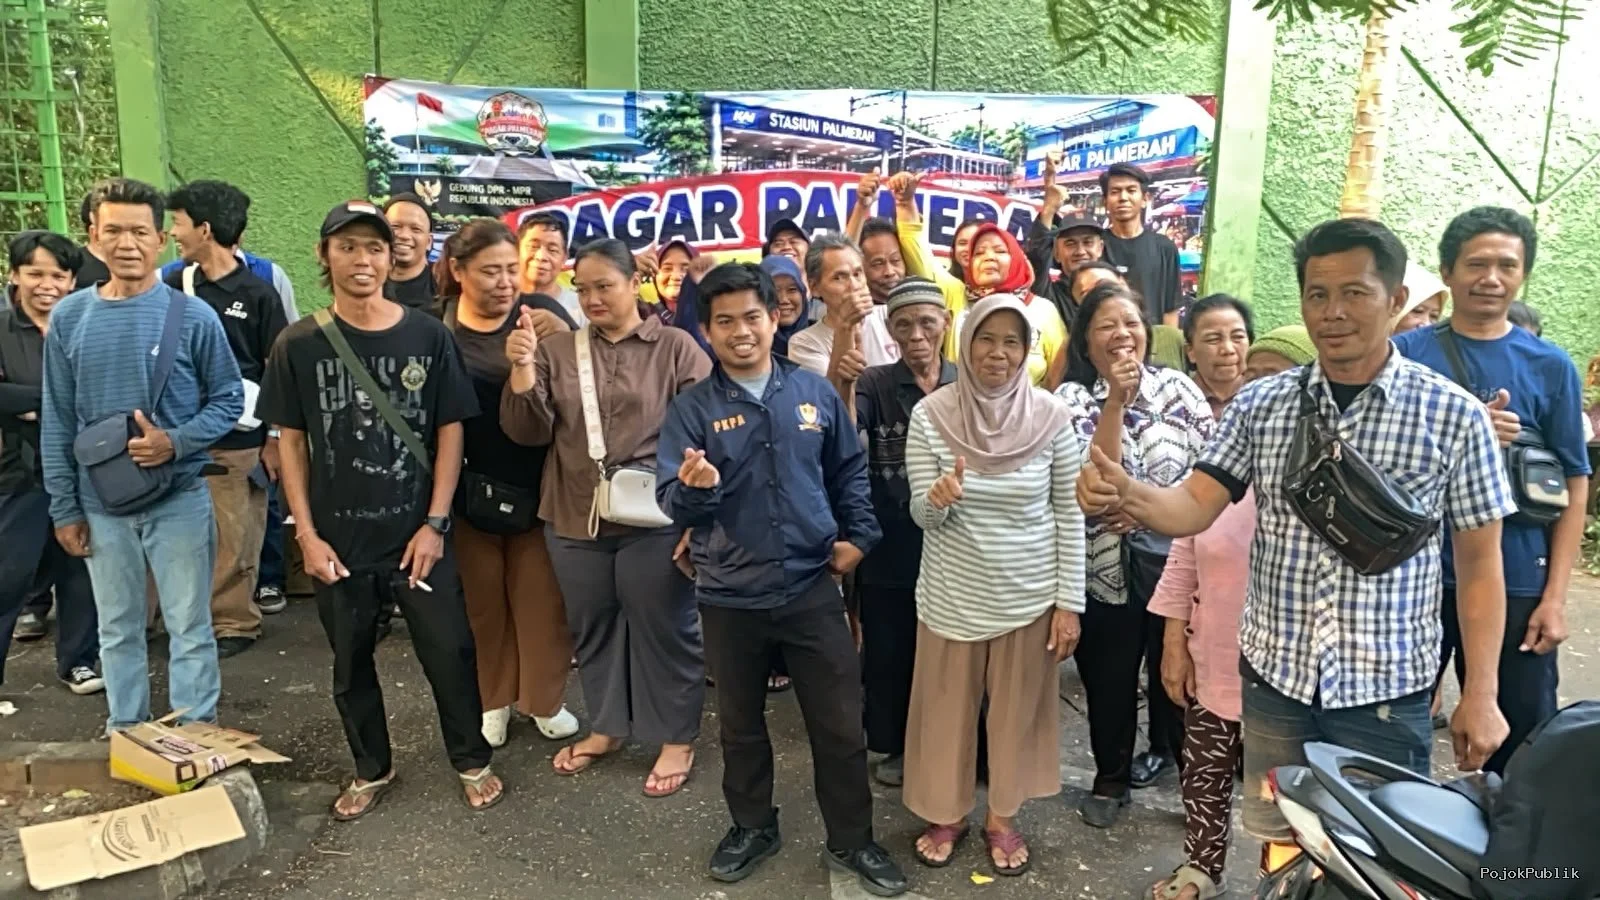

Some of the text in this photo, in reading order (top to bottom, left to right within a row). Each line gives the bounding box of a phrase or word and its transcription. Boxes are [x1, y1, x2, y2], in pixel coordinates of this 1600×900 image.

[769, 112, 876, 143] STASIUN PALMERAH
[1038, 134, 1177, 177] PAR PALMERAH
[449, 183, 485, 194] GEDUNG
[486, 185, 505, 194] DPR
[512, 186, 532, 195] MPR
[449, 194, 536, 206] REPUBLIK INDONESIA
[712, 414, 746, 433] PKPA
